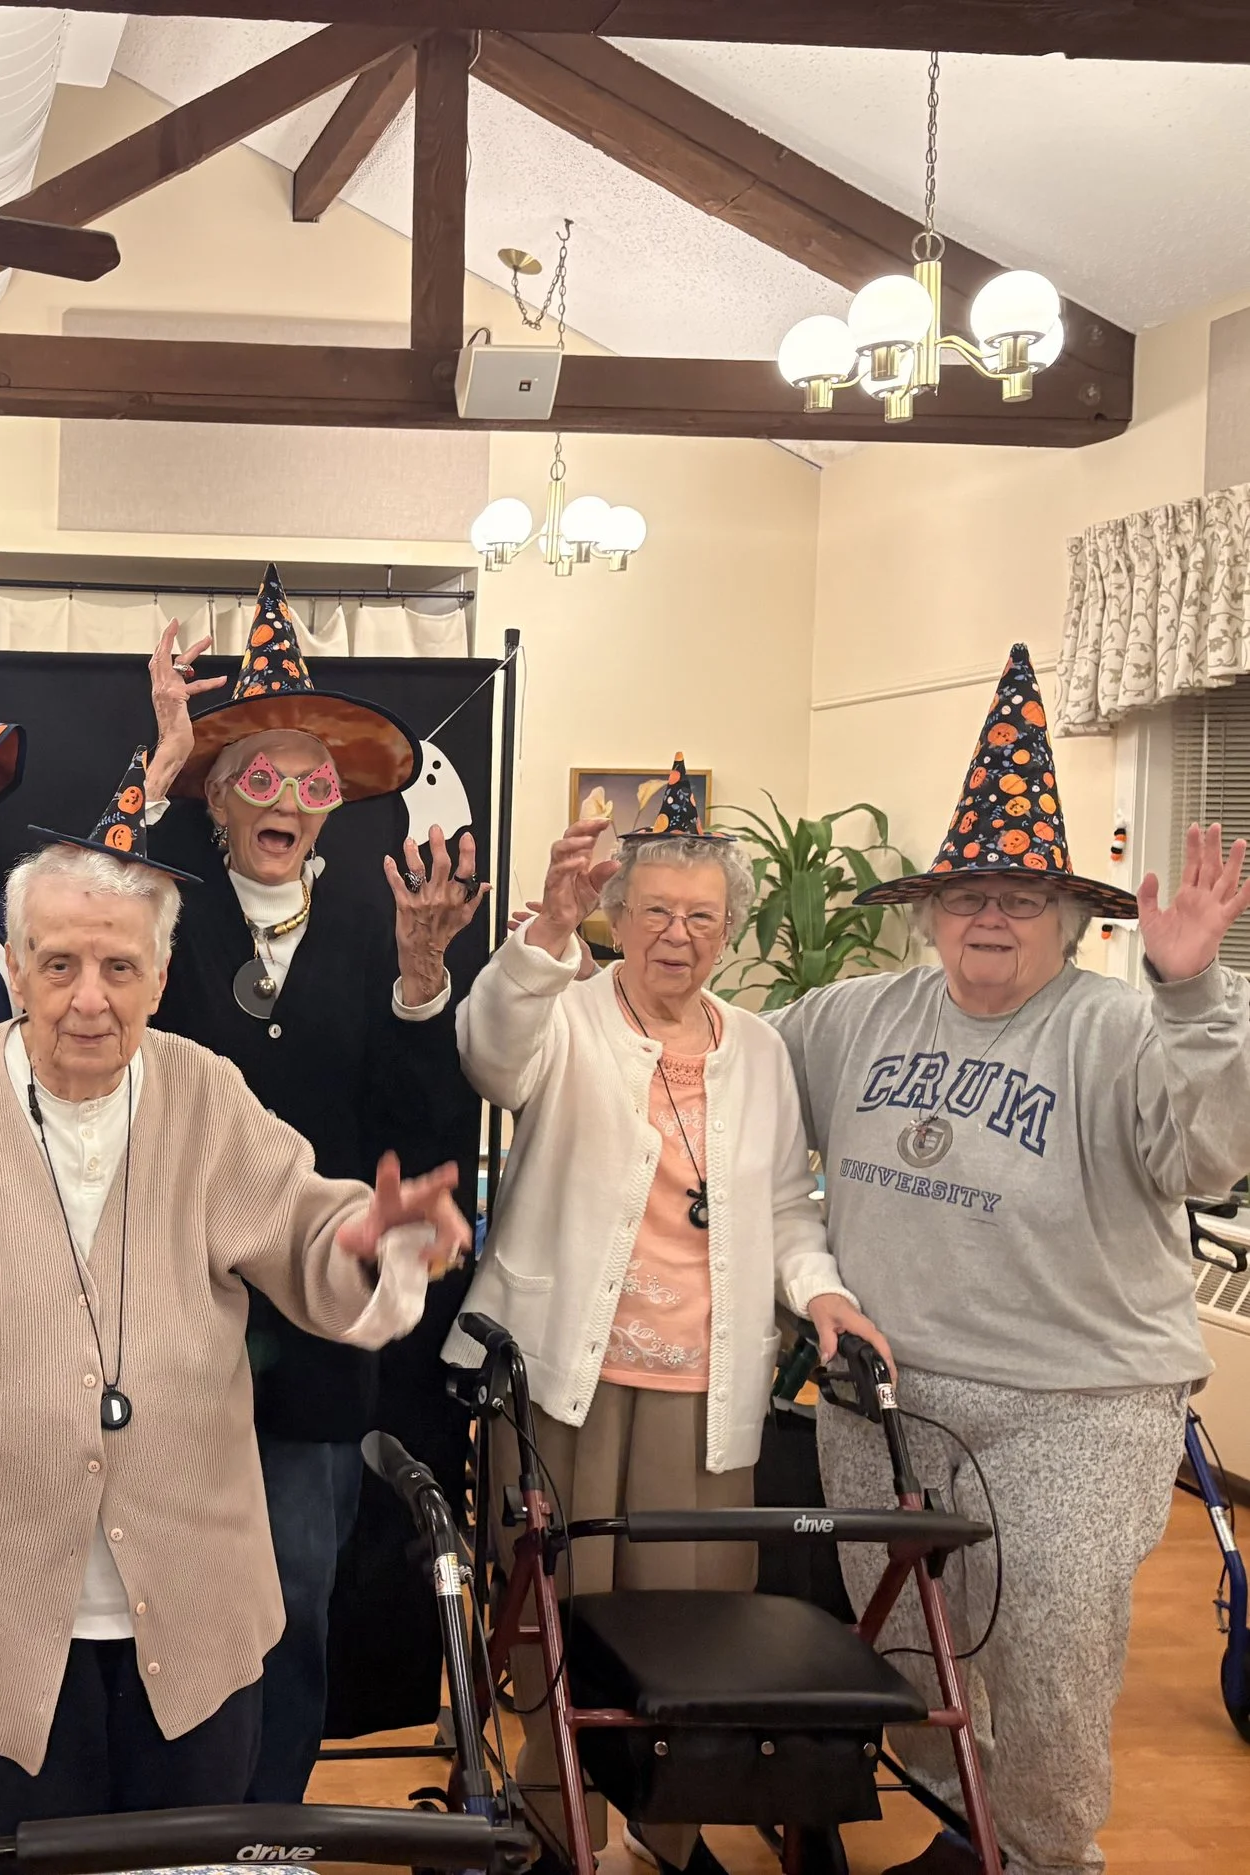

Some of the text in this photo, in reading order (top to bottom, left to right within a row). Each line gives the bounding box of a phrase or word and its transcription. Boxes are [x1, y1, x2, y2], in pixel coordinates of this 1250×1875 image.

[856, 1051, 1057, 1158] CRUM
[839, 1158, 1002, 1213] UNIVERSITY
[793, 1515, 834, 1533] drive
[236, 1843, 316, 1861] drive
